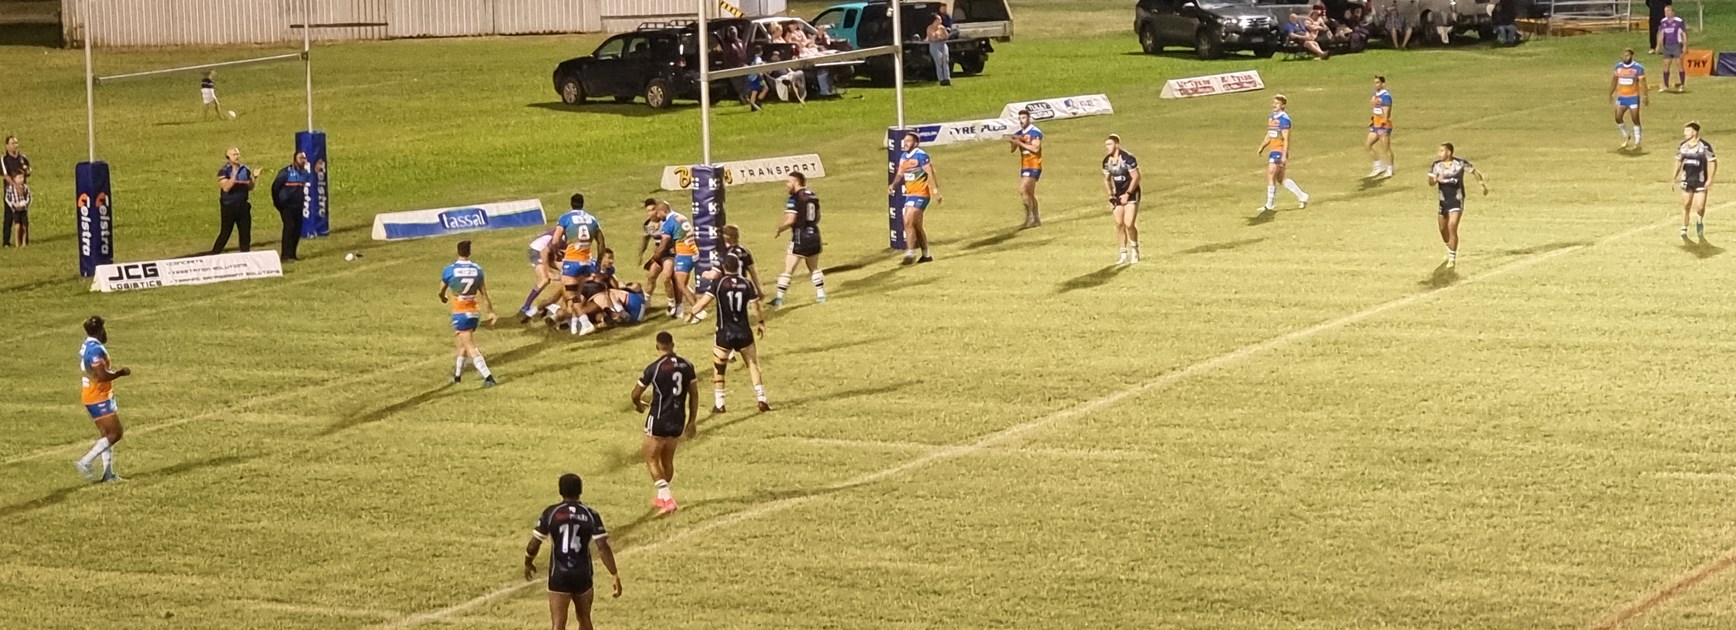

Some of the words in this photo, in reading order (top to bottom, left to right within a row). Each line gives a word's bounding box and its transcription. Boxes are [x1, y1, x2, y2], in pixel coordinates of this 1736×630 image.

[740, 163, 816, 178] TRANSPORT
[78, 193, 92, 256] Telstra
[95, 192, 110, 255] Telstra
[442, 210, 486, 229] tassal
[108, 263, 159, 281] JCG
[460, 278, 475, 294] 7
[727, 290, 742, 312] 11
[672, 371, 683, 396] 3
[559, 523, 582, 553] 14
